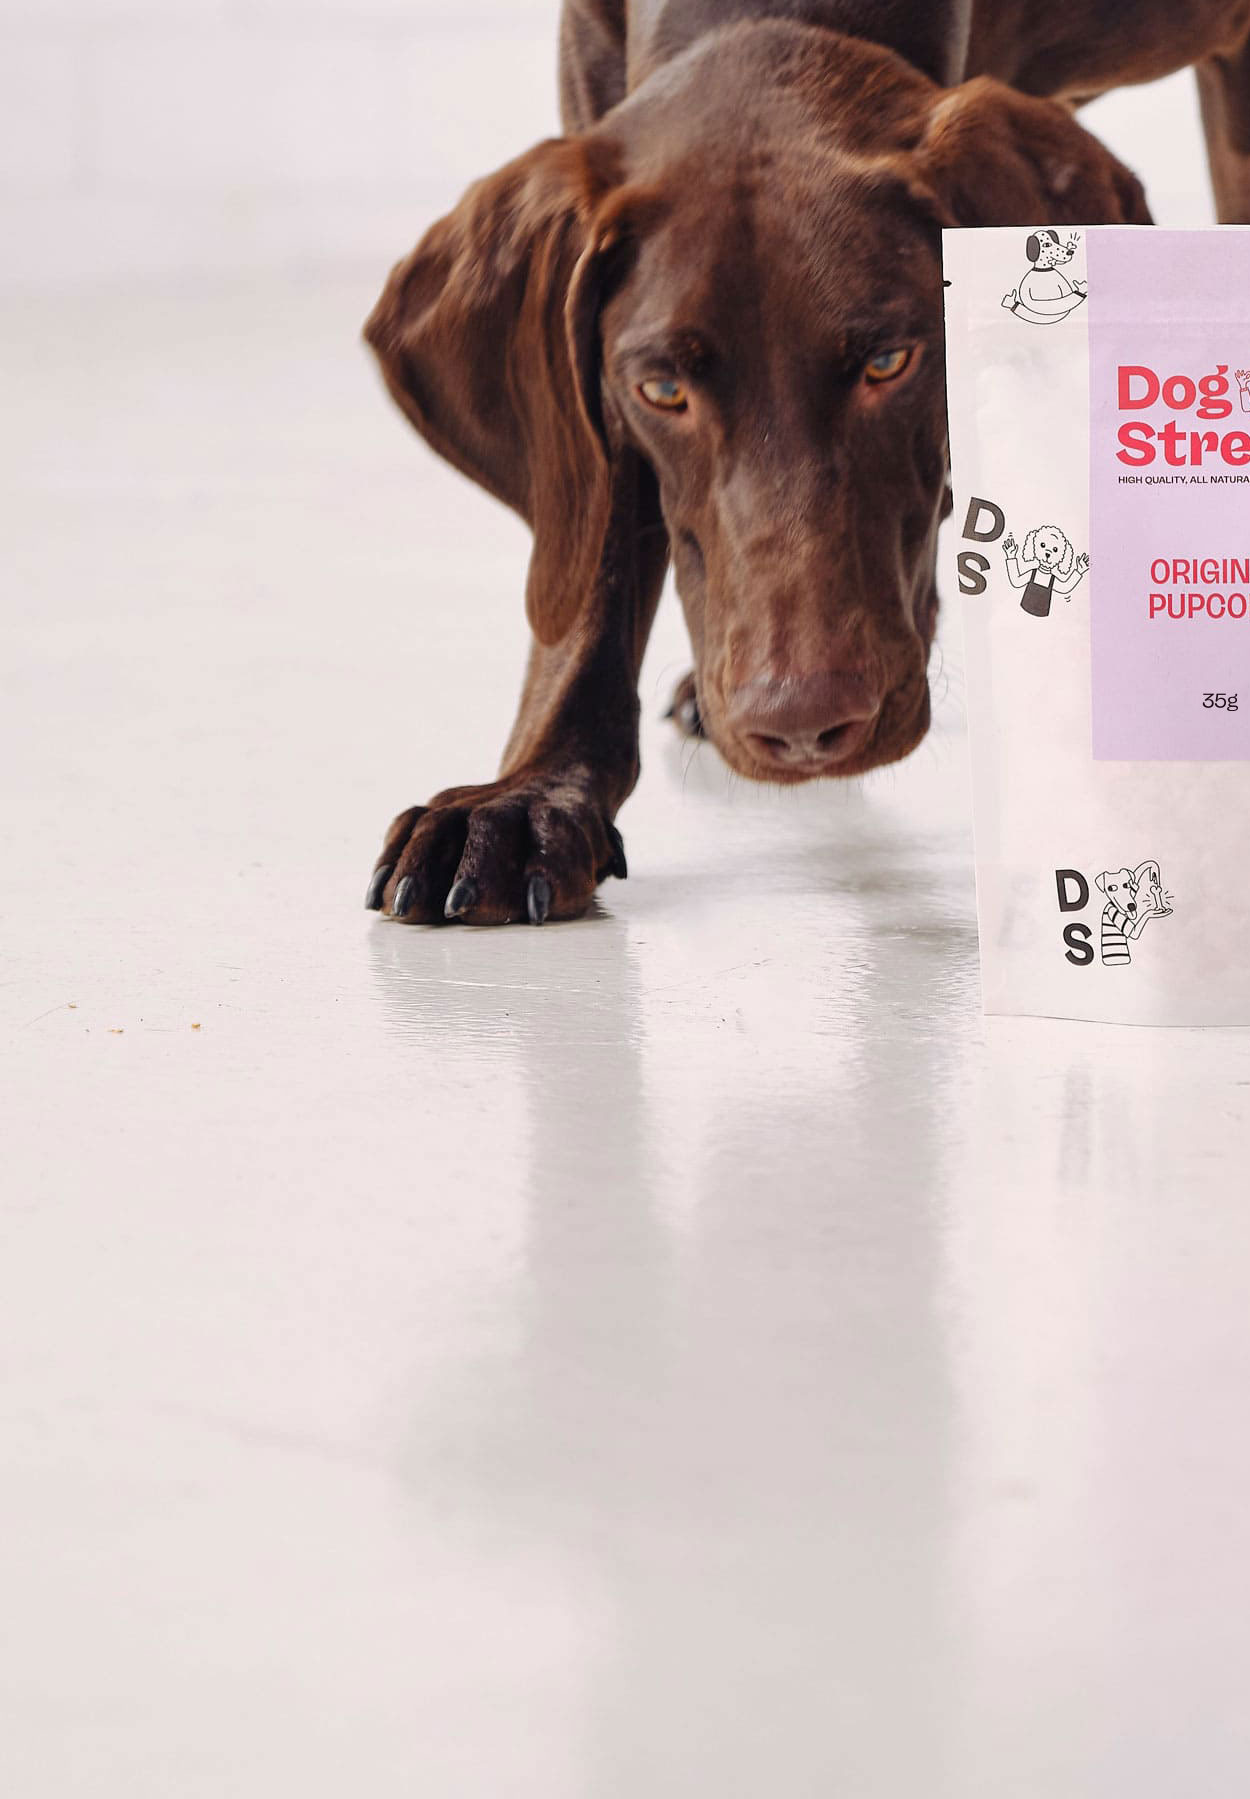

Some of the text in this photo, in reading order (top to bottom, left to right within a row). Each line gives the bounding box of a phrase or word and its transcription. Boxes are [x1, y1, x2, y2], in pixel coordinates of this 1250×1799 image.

[1117, 364, 1233, 420] Dog
[1118, 475, 1143, 484] HIGH
[1144, 475, 1188, 486] QUALITY,
[1189, 475, 1209, 484] ALL
[962, 497, 1005, 542] D
[957, 552, 990, 595] S
[1202, 693, 1238, 711] 35g
[1057, 869, 1090, 912] D
[1063, 923, 1094, 966] S
